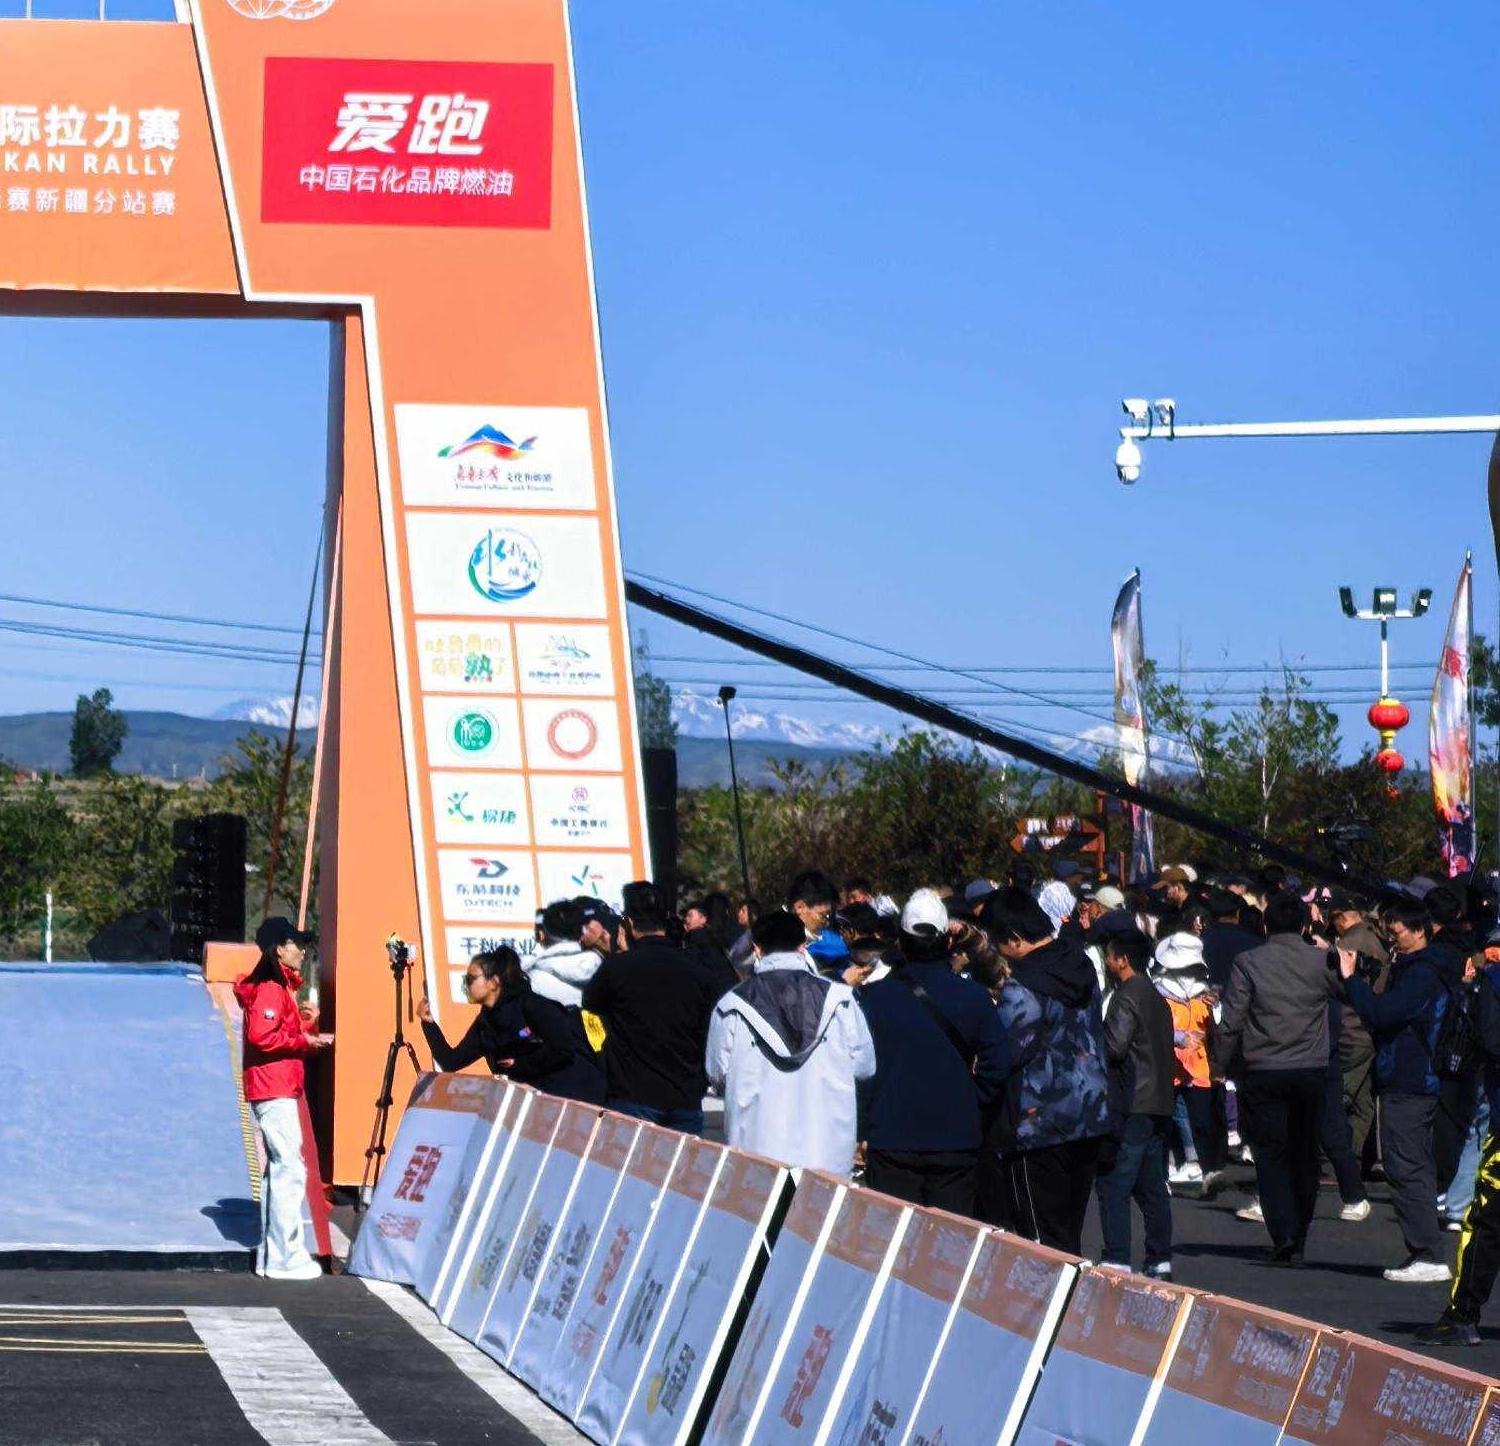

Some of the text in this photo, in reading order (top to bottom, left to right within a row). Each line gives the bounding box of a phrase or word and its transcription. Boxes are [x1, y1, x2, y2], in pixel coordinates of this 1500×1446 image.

[327, 91, 491, 156] 爱跑
[81, 153, 175, 176] RALLY
[299, 163, 514, 198] 中国石化品牌燃油
